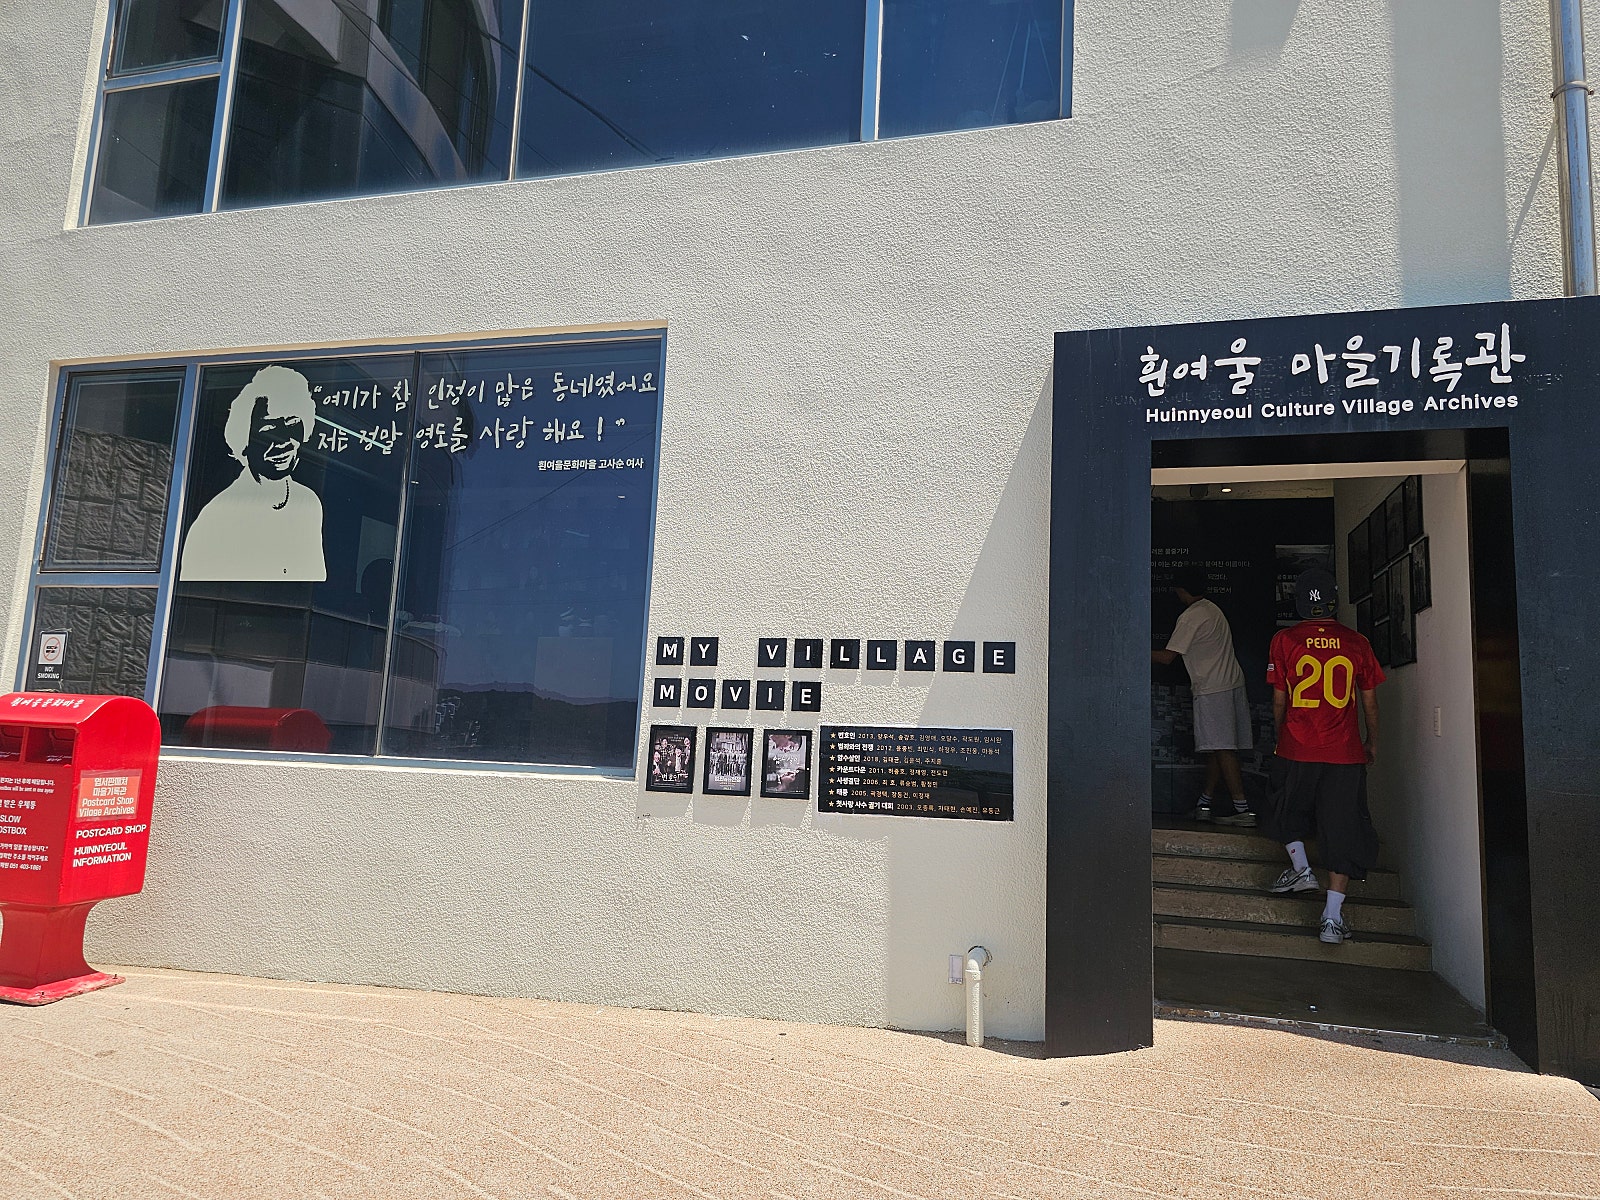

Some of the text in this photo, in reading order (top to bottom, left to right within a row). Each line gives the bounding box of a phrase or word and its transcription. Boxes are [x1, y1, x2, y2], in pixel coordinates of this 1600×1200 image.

[1138, 322, 1527, 397] 흰여울 마을기록관
[391, 378, 412, 413] 참
[428, 377, 485, 409] 인정이
[495, 372, 534, 408] 많은
[552, 370, 657, 402] 동네였어요
[1145, 392, 1520, 424] Huinnyeoul Culture Village Archives
[317, 427, 349, 451] 저는
[358, 420, 403, 456] 정말
[414, 416, 469, 453] 영도를
[479, 417, 534, 450] 사랑
[537, 456, 644, 472] 흰여울문화마을 고사순 여사
[1306, 638, 1341, 650] PEDRI
[662, 643, 1005, 666] MY VILLAGE
[1292, 654, 1354, 709] 20
[659, 684, 812, 705] MOVIE
[836, 766, 867, 774] 카운트다운
[93, 786, 127, 796] 마을기록관
[82, 797, 134, 806] Postcard Shop
[836, 800, 854, 808] 첫사랑
[0, 814, 22, 823] SLOW
[103, 806, 135, 816] Archives
[76, 824, 147, 839] POSTCARD SHOP
[74, 842, 127, 856] HUINNYEOUL
[72, 853, 132, 868] INFORMATION
